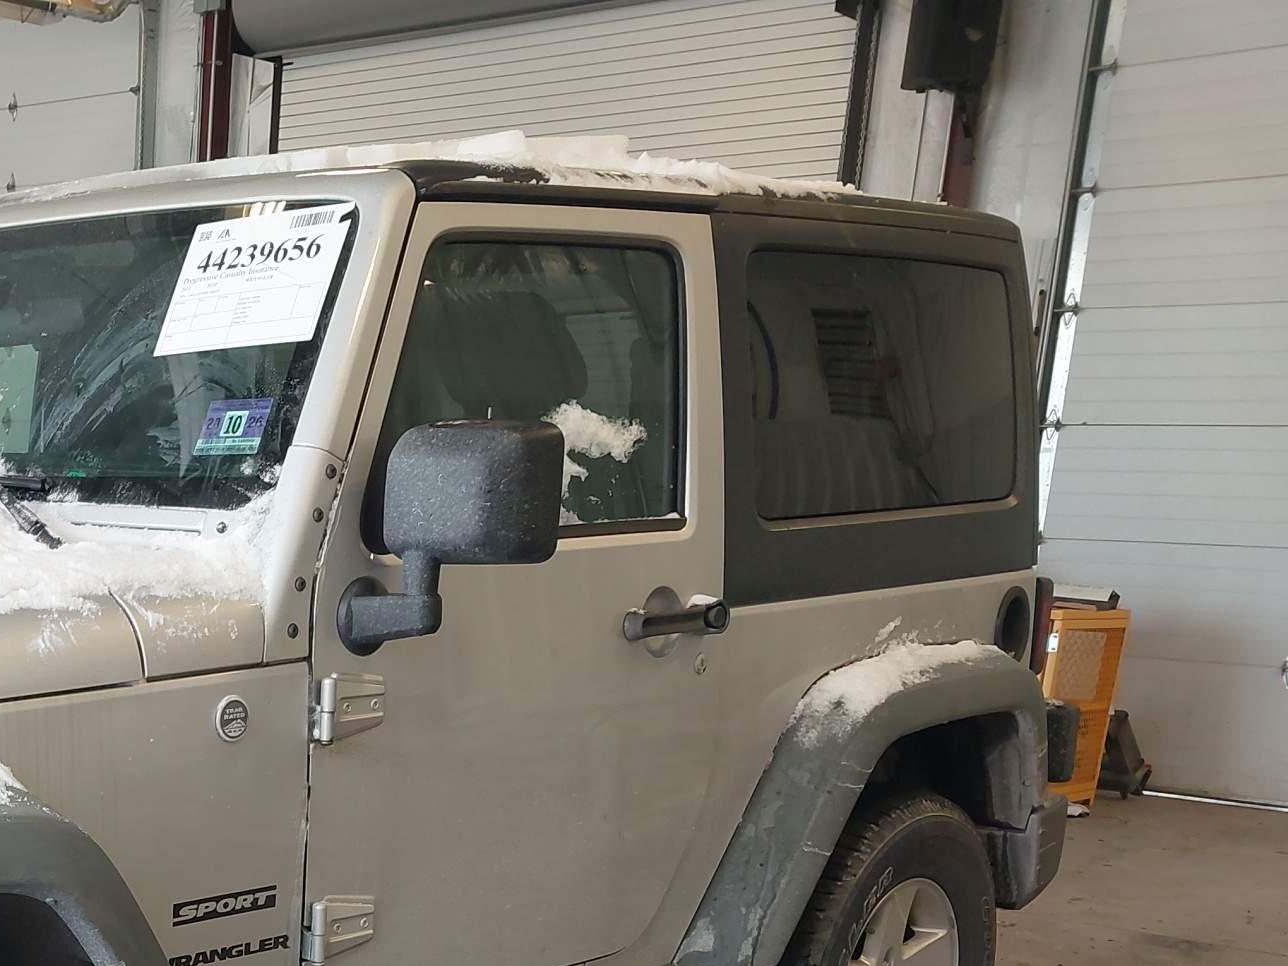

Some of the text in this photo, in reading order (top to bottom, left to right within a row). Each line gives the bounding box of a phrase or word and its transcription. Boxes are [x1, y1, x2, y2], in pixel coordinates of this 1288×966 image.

[197, 234, 325, 273] 44239656
[224, 415, 243, 435] 10
[247, 416, 264, 428] 26
[223, 712, 246, 720] RATED
[172, 889, 277, 922] SPORT
